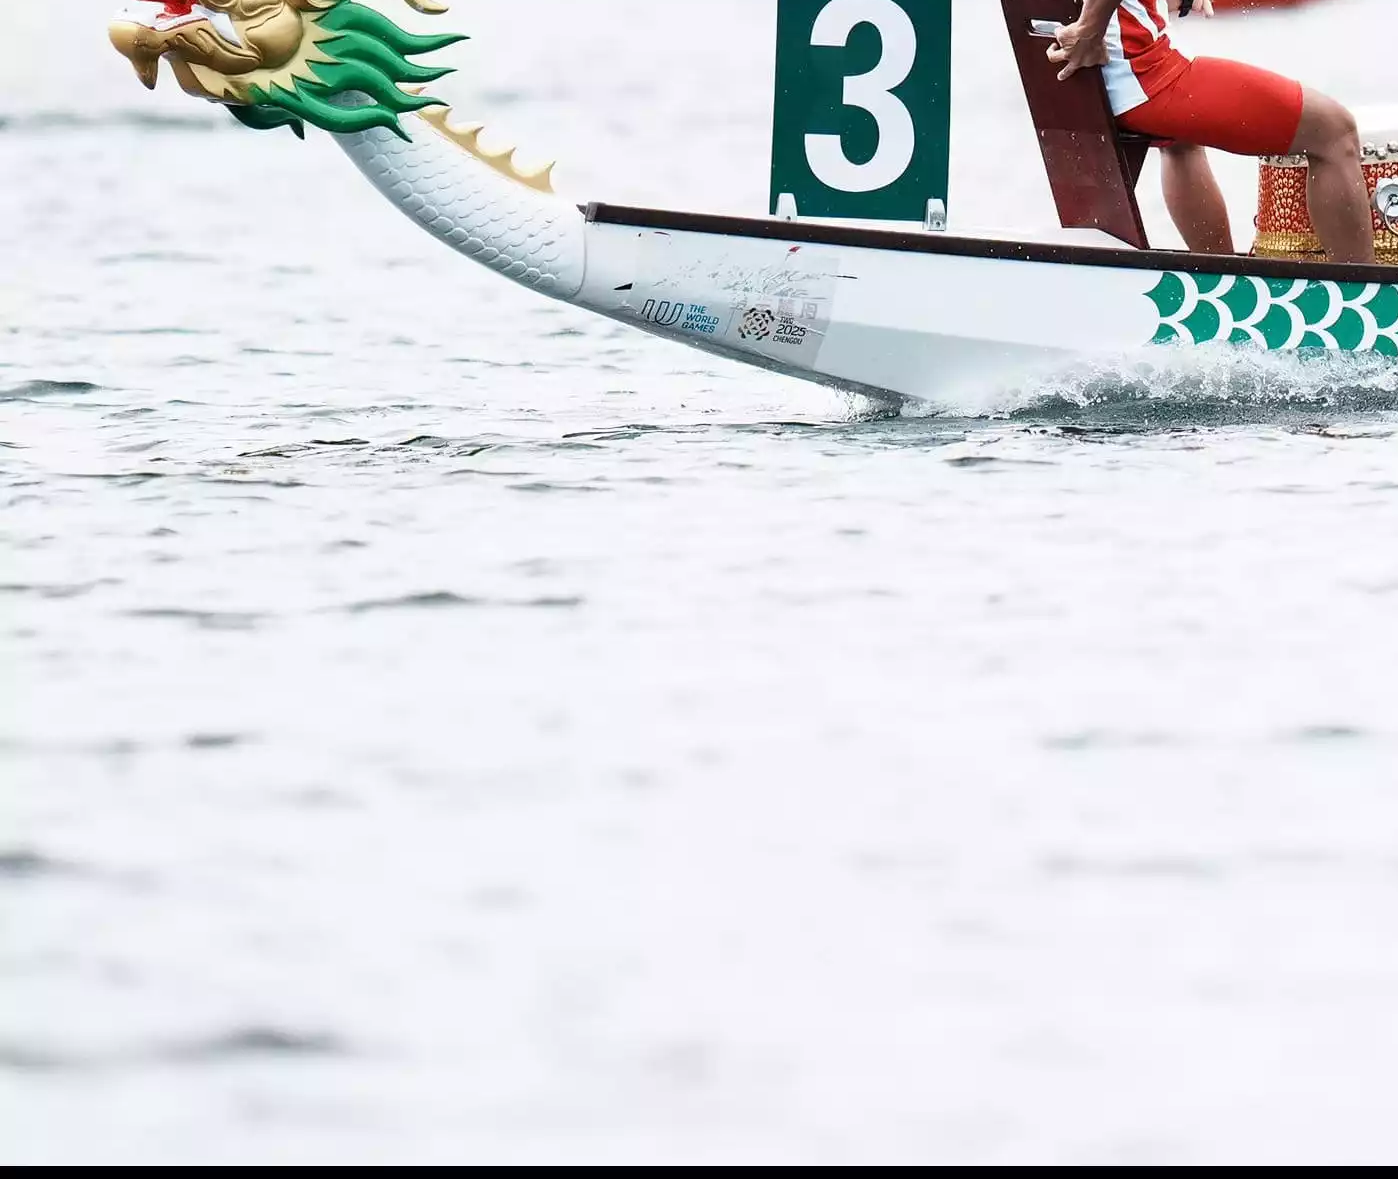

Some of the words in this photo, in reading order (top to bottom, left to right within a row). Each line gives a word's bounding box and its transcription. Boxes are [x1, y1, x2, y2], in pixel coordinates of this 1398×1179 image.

[690, 304, 707, 314] THE
[686, 312, 720, 325] WORLD
[681, 321, 715, 333] GAMES
[775, 323, 807, 337] 2025
[772, 334, 803, 345] CHENGDU
